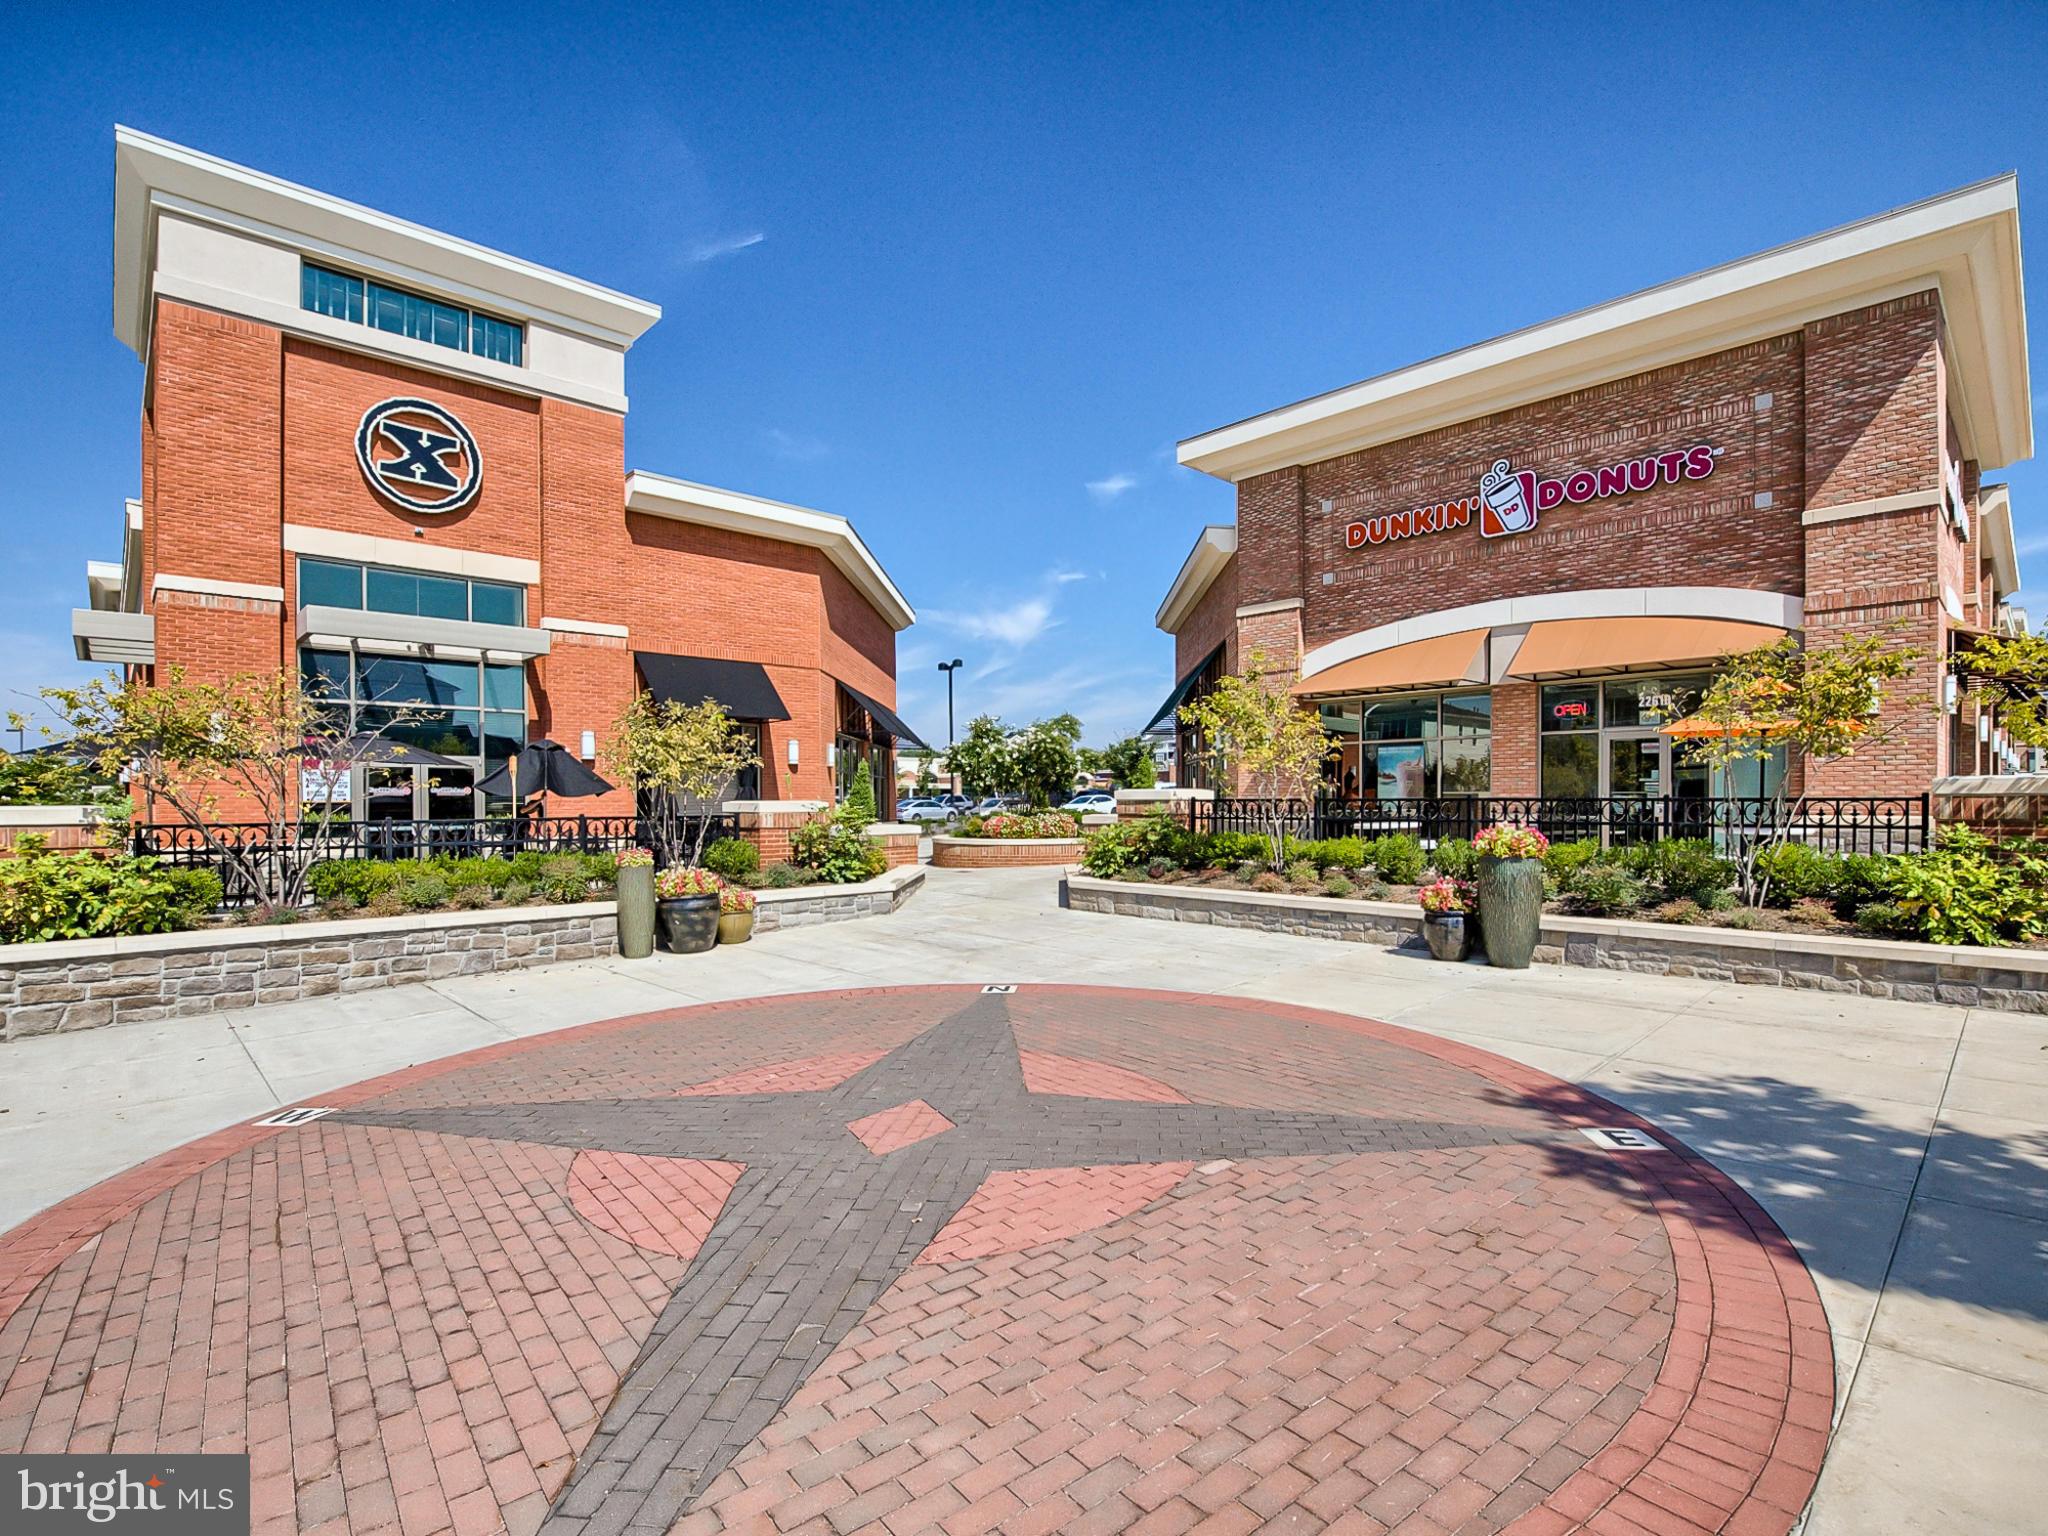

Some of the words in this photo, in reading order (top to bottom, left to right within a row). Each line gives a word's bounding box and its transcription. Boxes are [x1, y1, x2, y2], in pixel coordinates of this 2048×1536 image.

[1345, 496, 1479, 549] DUNKIN'
[1537, 445, 1714, 510] DONUTS
[1503, 503, 1519, 516] DD
[1554, 702, 1588, 717] OPEN
[1599, 1129, 1647, 1147] E
